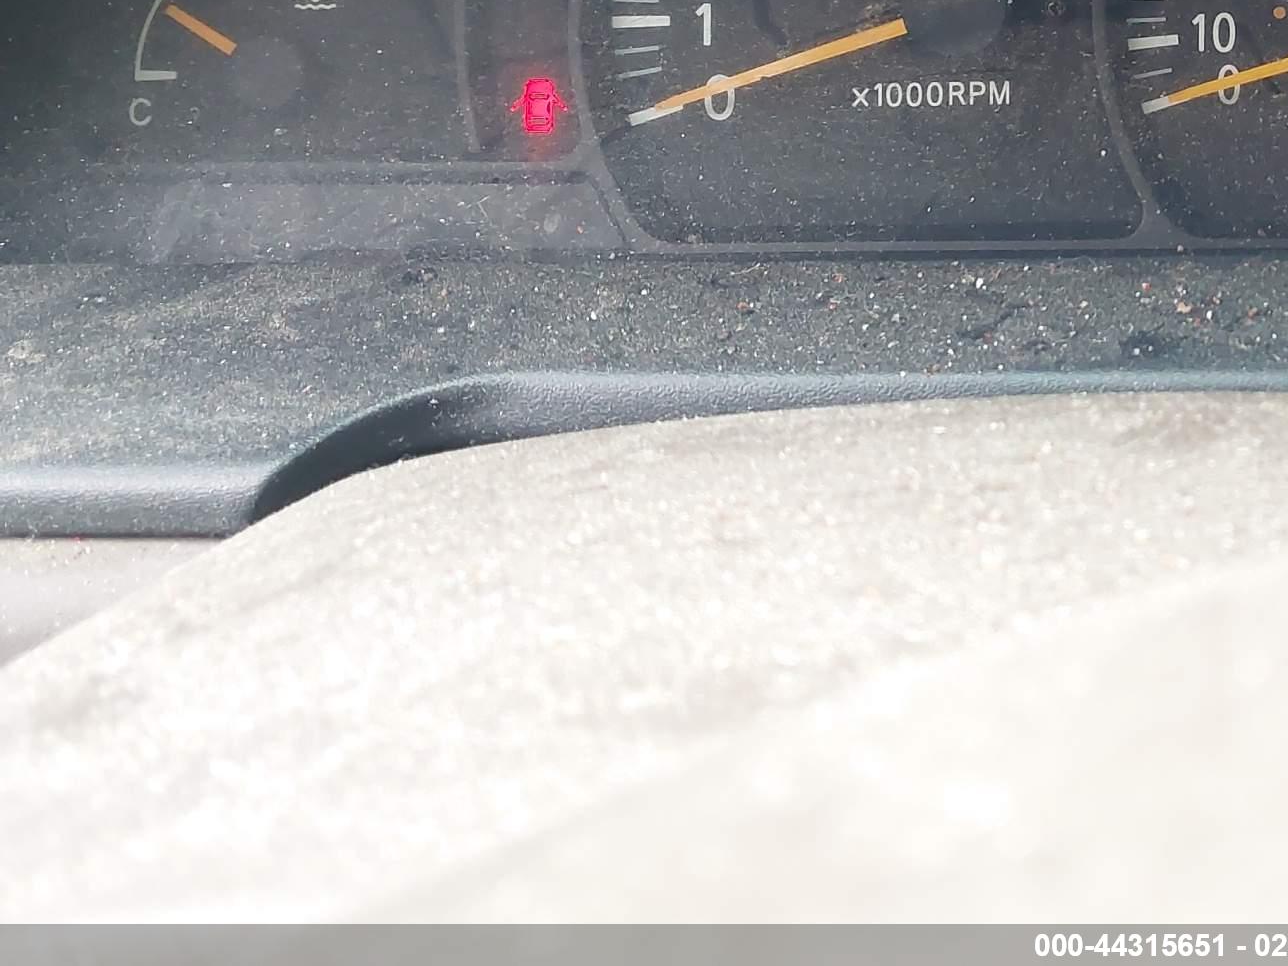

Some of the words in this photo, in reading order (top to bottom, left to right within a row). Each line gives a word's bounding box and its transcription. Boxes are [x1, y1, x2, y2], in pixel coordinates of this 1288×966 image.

[695, 3, 712, 46] 1
[1191, 13, 1236, 53] 10
[703, 74, 735, 121] 0
[1218, 64, 1241, 105] 0
[128, 98, 152, 126] C
